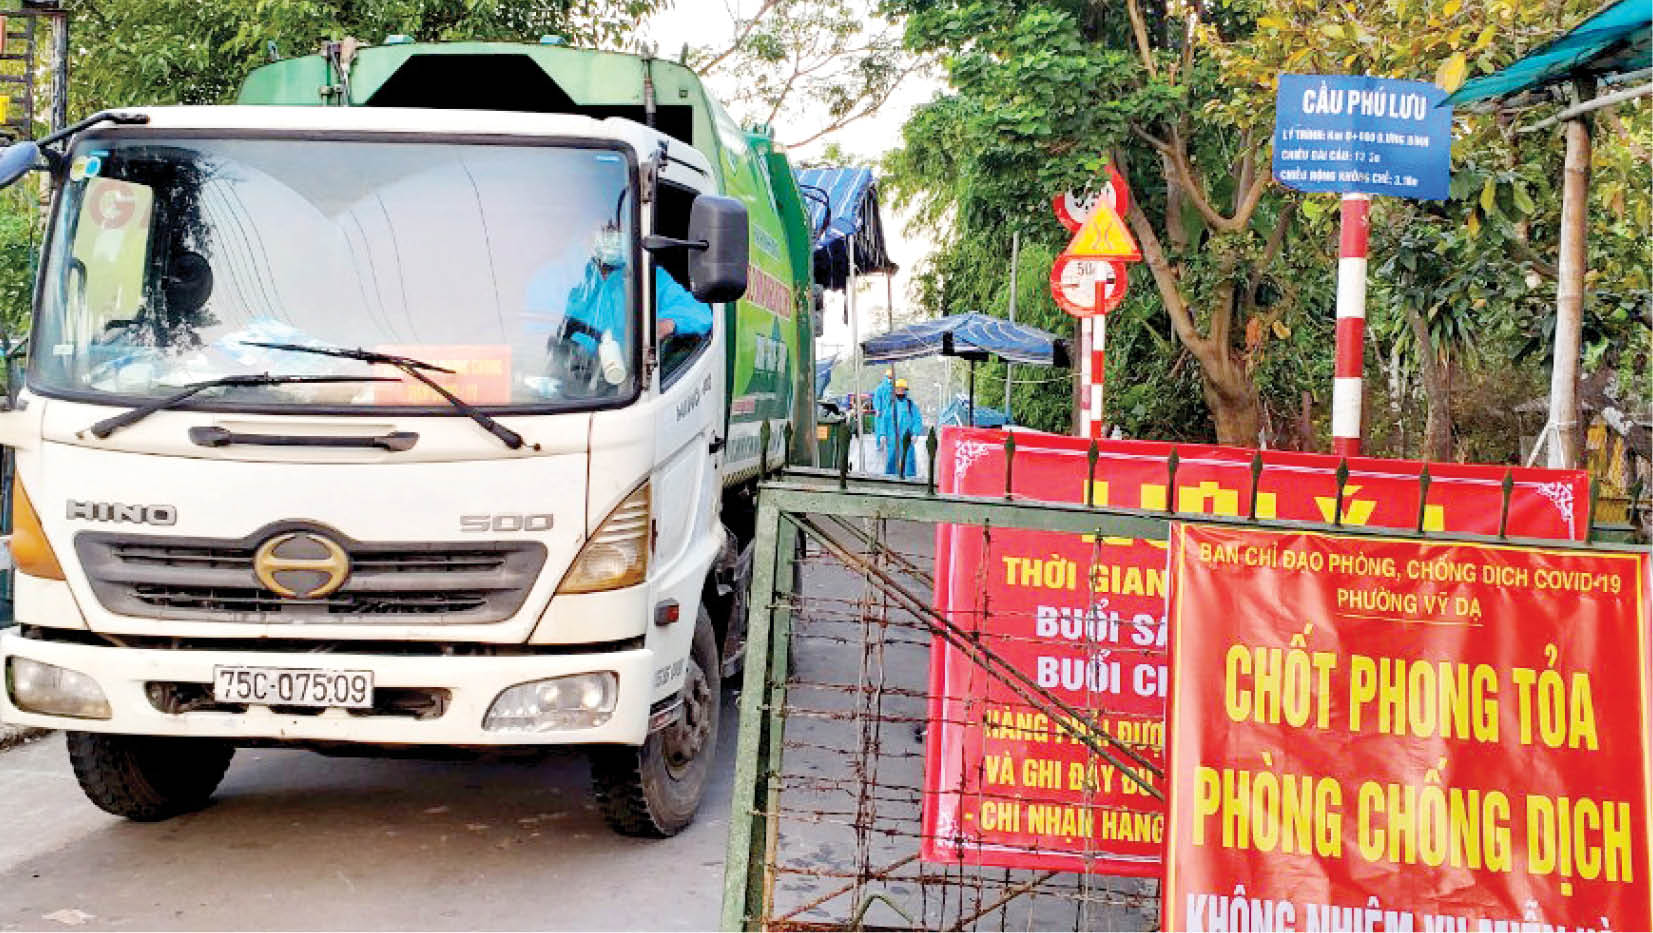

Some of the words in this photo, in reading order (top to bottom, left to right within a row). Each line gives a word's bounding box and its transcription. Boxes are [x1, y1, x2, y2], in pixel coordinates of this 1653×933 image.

[1302, 80, 1343, 114] CẦU
[1347, 86, 1385, 117] PHÚ
[1390, 93, 1427, 120] LƯU
[66, 499, 177, 525] HINO
[460, 513, 553, 532] 500
[1002, 553, 1077, 590] THỜI
[1089, 565, 1167, 598] GIAN
[1200, 542, 1239, 565] BAN
[1245, 541, 1278, 569] CHỈ
[1282, 551, 1325, 573] ĐẠO
[1328, 552, 1401, 581] PHÒNG,
[1406, 554, 1477, 583] CHỐNG
[1482, 565, 1528, 588] DỊCH
[1534, 569, 1621, 594] COVID-19
[1036, 597, 1119, 644] BUỔI
[1337, 587, 1418, 614] PHƯỜNG
[1423, 592, 1449, 616] VỸ
[1455, 596, 1482, 623] DẠ
[1036, 649, 1121, 694] BUỔI
[1225, 624, 1337, 730] CHỐT
[1349, 655, 1500, 744] PHONG
[1512, 642, 1599, 751] TỎA
[985, 705, 1048, 743] HÀNG
[985, 751, 1016, 787] VÀ
[1022, 758, 1062, 789] GHI
[1191, 752, 1343, 859] PHÒNG
[1357, 758, 1512, 873] CHỐNG
[1526, 794, 1634, 897] DỊCH
